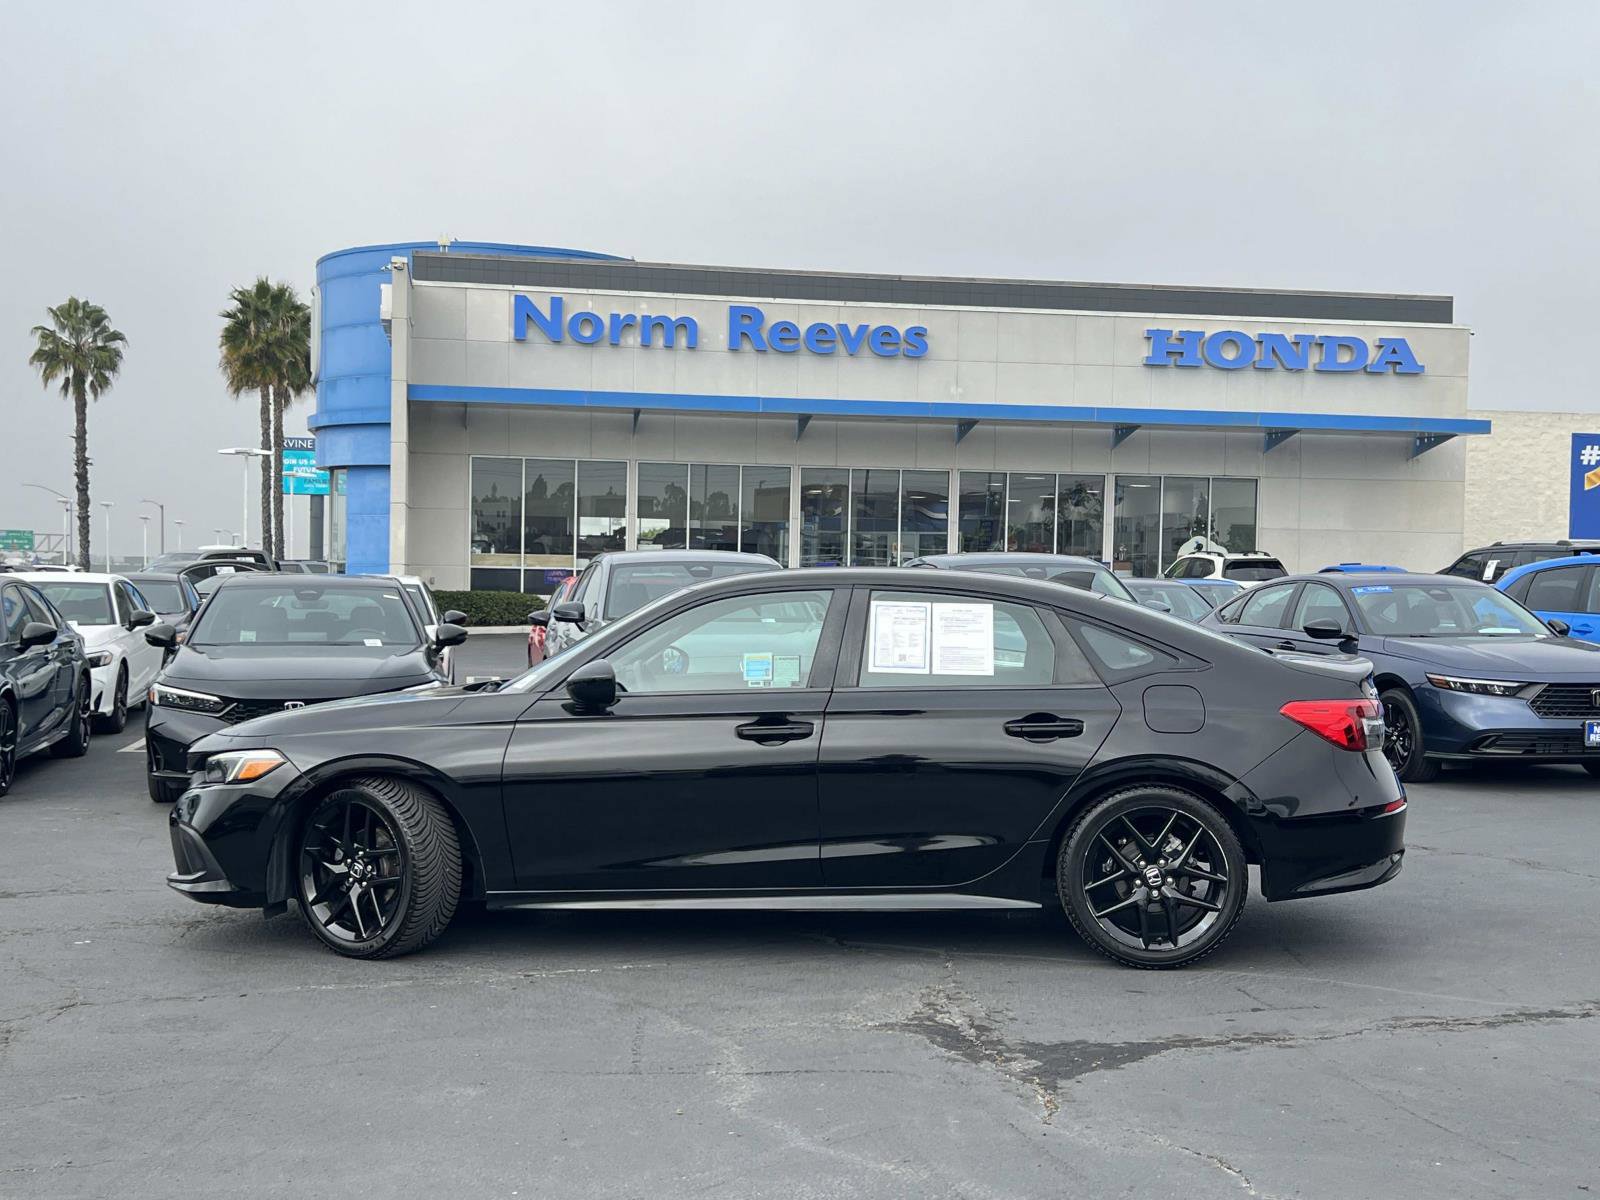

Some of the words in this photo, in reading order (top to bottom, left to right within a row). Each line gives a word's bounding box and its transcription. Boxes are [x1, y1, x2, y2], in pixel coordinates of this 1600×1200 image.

[513, 294, 699, 349] Norm
[728, 304, 929, 358] Reeves
[1143, 328, 1425, 374] HONDA
[283, 439, 313, 448] RVINE
